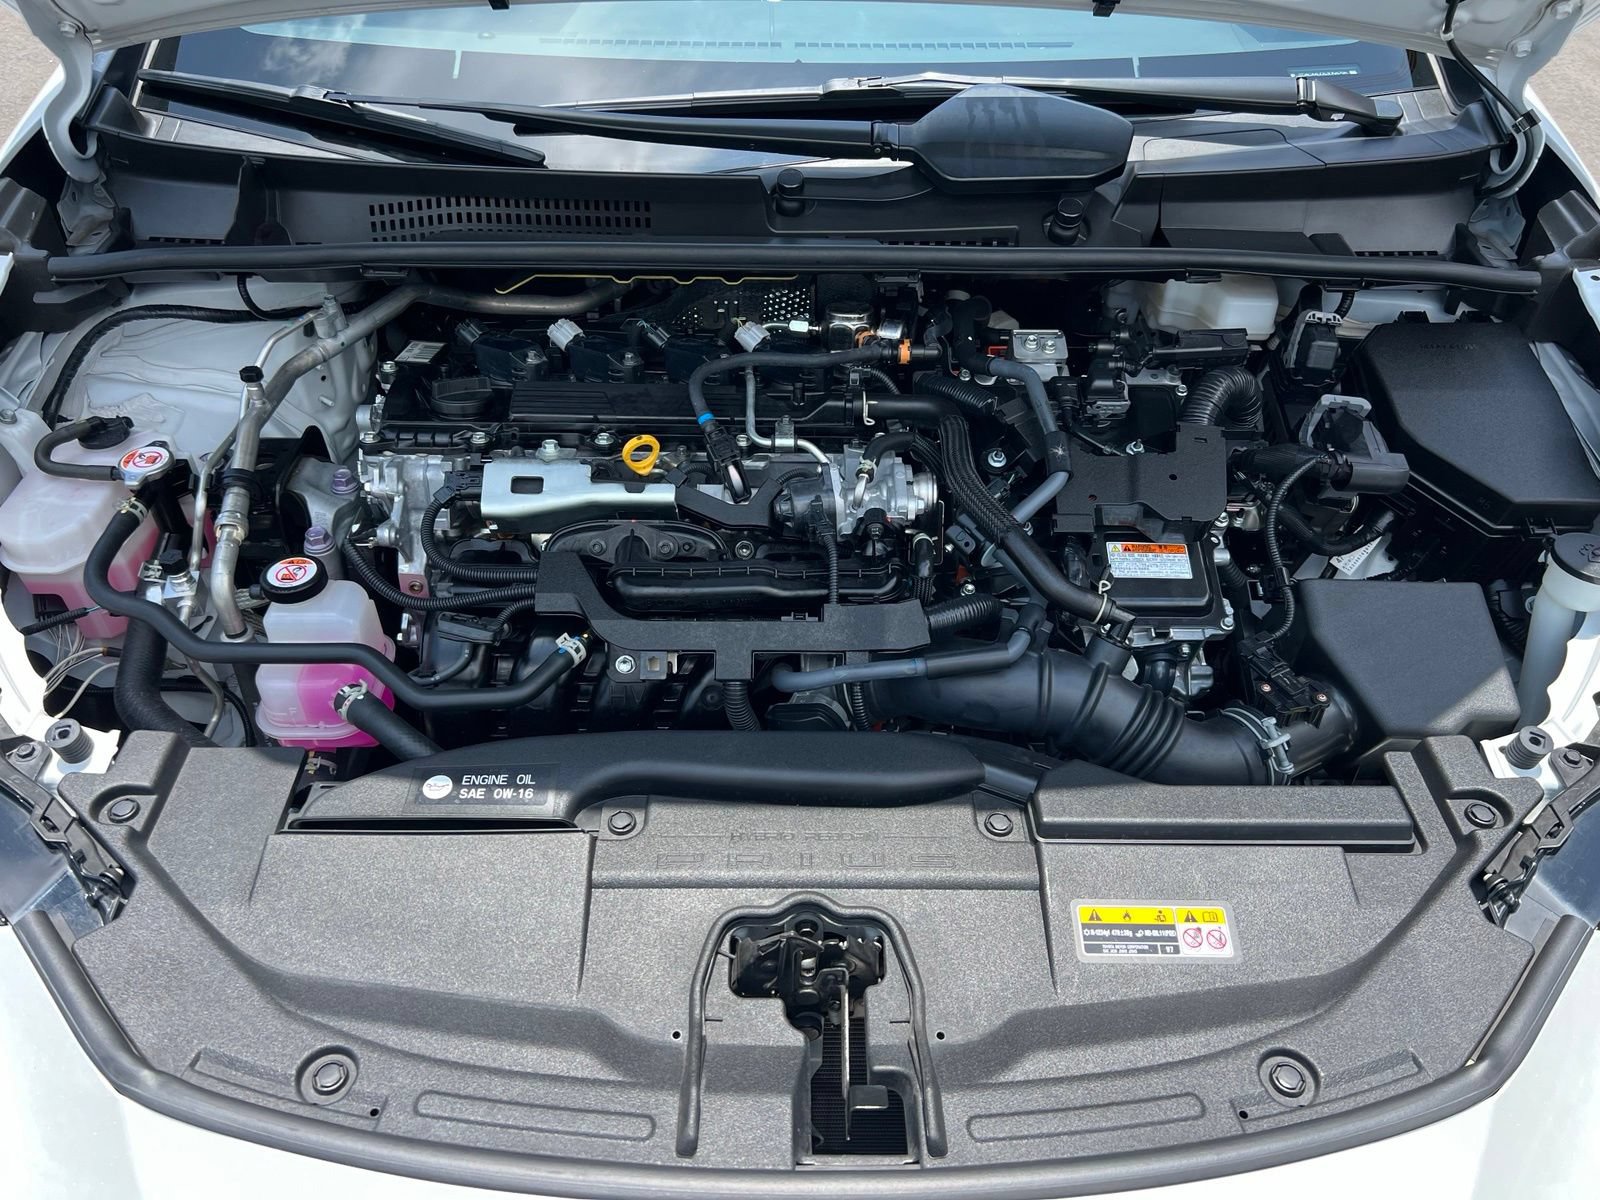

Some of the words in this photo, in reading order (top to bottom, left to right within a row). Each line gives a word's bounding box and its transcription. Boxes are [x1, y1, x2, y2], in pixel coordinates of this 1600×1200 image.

[461, 774, 509, 785] ENGINE
[516, 774, 536, 785] OIL
[459, 788, 486, 799] SAE
[493, 788, 534, 799] 0W-16
[656, 852, 956, 869] PRIUS
